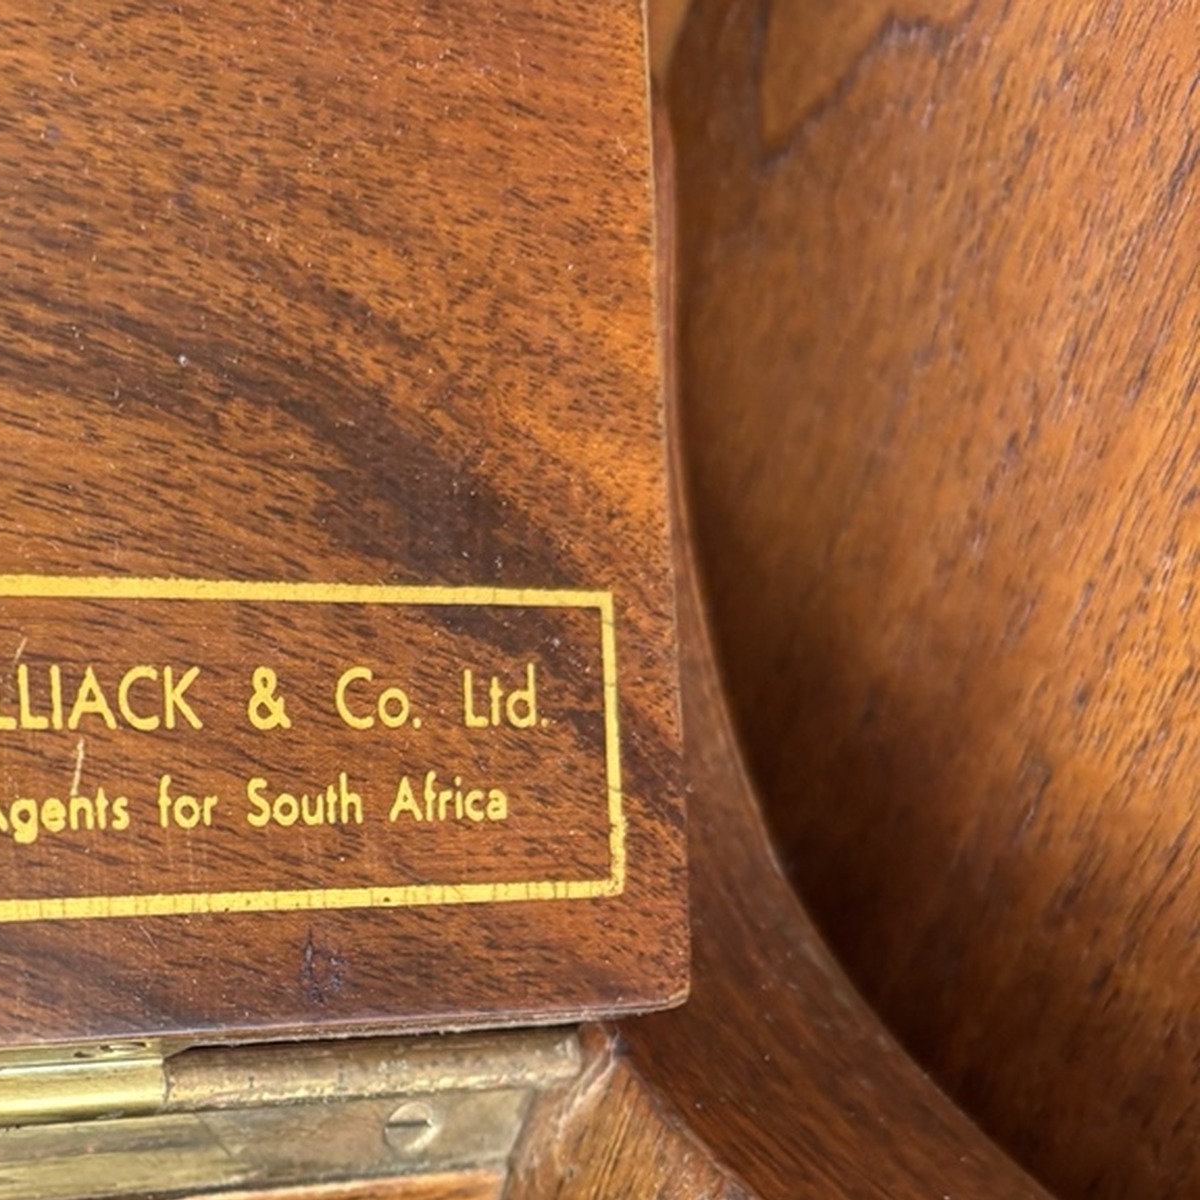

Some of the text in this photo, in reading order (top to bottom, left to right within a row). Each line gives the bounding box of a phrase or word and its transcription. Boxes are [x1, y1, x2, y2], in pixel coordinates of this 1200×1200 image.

[246, 666, 292, 729] &
[334, 668, 422, 729] Co.
[463, 662, 555, 729] Ltd.
[157, 774, 218, 833] for
[246, 771, 364, 827] South
[388, 771, 508, 822] Africa
